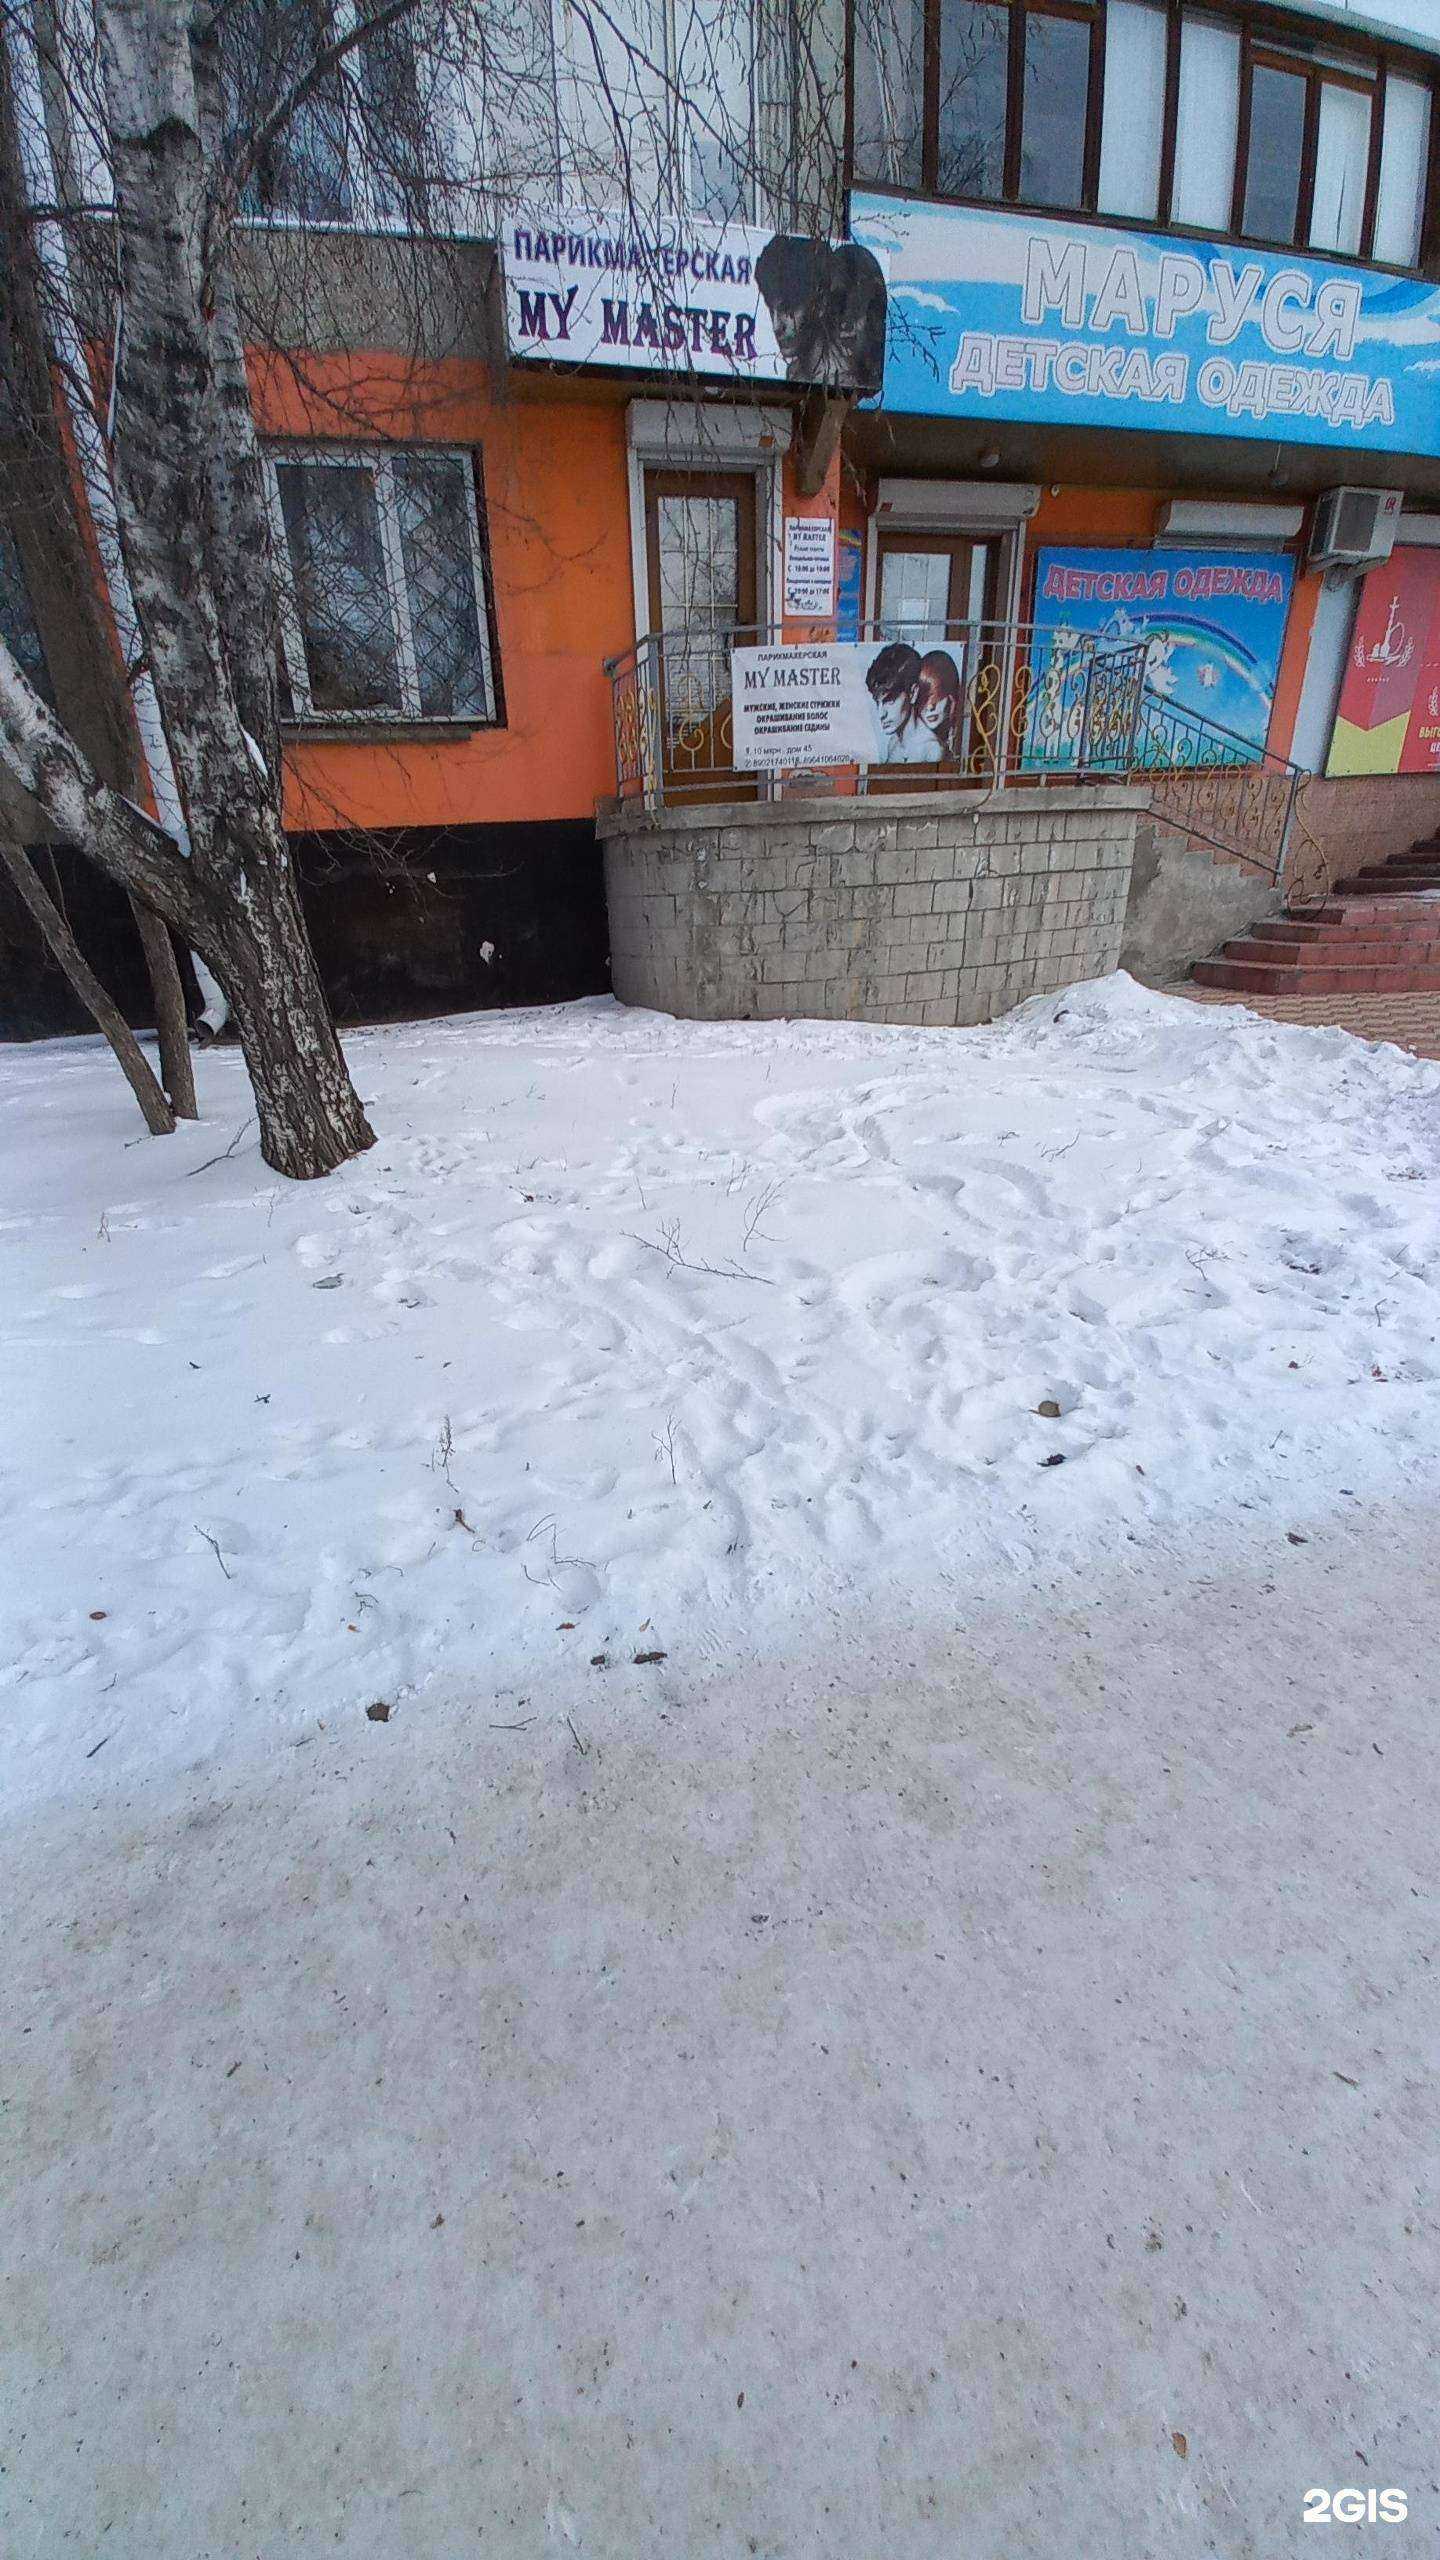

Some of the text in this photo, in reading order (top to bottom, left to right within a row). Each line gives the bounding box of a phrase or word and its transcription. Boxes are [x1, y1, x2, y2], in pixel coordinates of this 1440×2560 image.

[1021, 236, 1365, 361] МАРУСЯ
[517, 284, 758, 360] MY MASTER
[949, 331, 1396, 427] ДЕТСКАЯ ОДЕЖДА
[1043, 563, 1283, 603] ДЕТСКАЯ ОДЕЖДА
[757, 651, 828, 661] ПАРИКМАХЕРСКАЯ
[744, 666, 841, 689] MY MASTER
[756, 711, 829, 723] ОКРАШИВАНИЕ ВОЛОС
[778, 700, 810, 711] ЖЕНСКИЕ
[754, 724, 803, 735] ОКРАШИВАНИЕ
